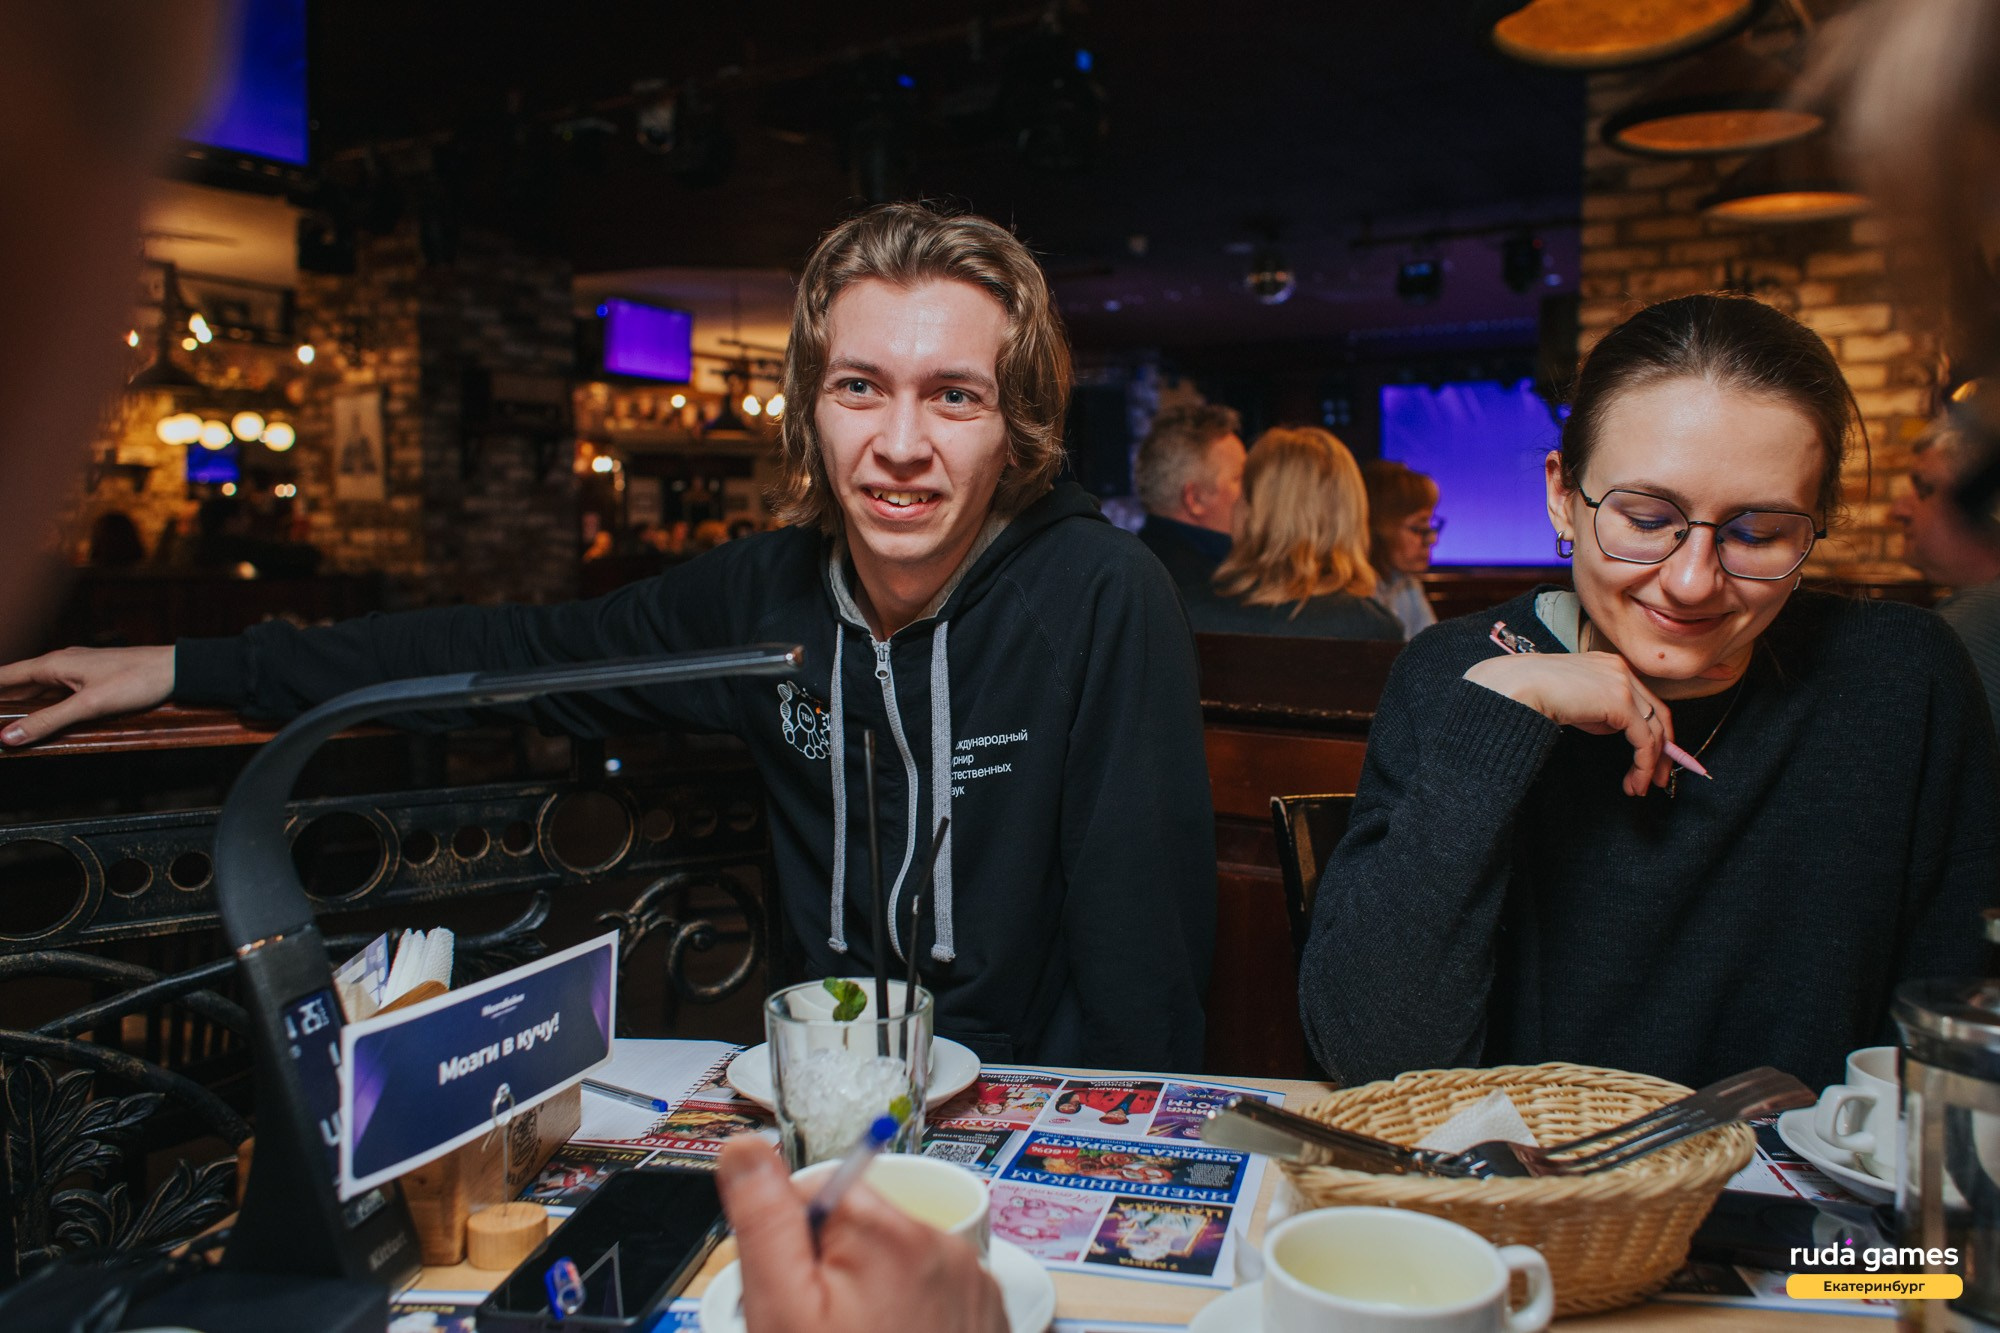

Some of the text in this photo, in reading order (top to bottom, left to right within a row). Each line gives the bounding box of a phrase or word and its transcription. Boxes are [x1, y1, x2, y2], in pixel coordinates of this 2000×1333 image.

[955, 729, 1029, 751] ждународный
[952, 754, 974, 767] рнир
[951, 763, 1012, 780] стественных
[951, 785, 965, 797] аук
[438, 1012, 560, 1086] Мозги в кучу!
[1167, 1098, 1193, 1108] FM
[1166, 1106, 1207, 1116] ИНКА
[1031, 1146, 1061, 1155] 60%
[1034, 1137, 1243, 1162] СКИДКА=ВОЗРАСТУ
[1009, 1168, 1230, 1202] ИМЕНИННИКАМ
